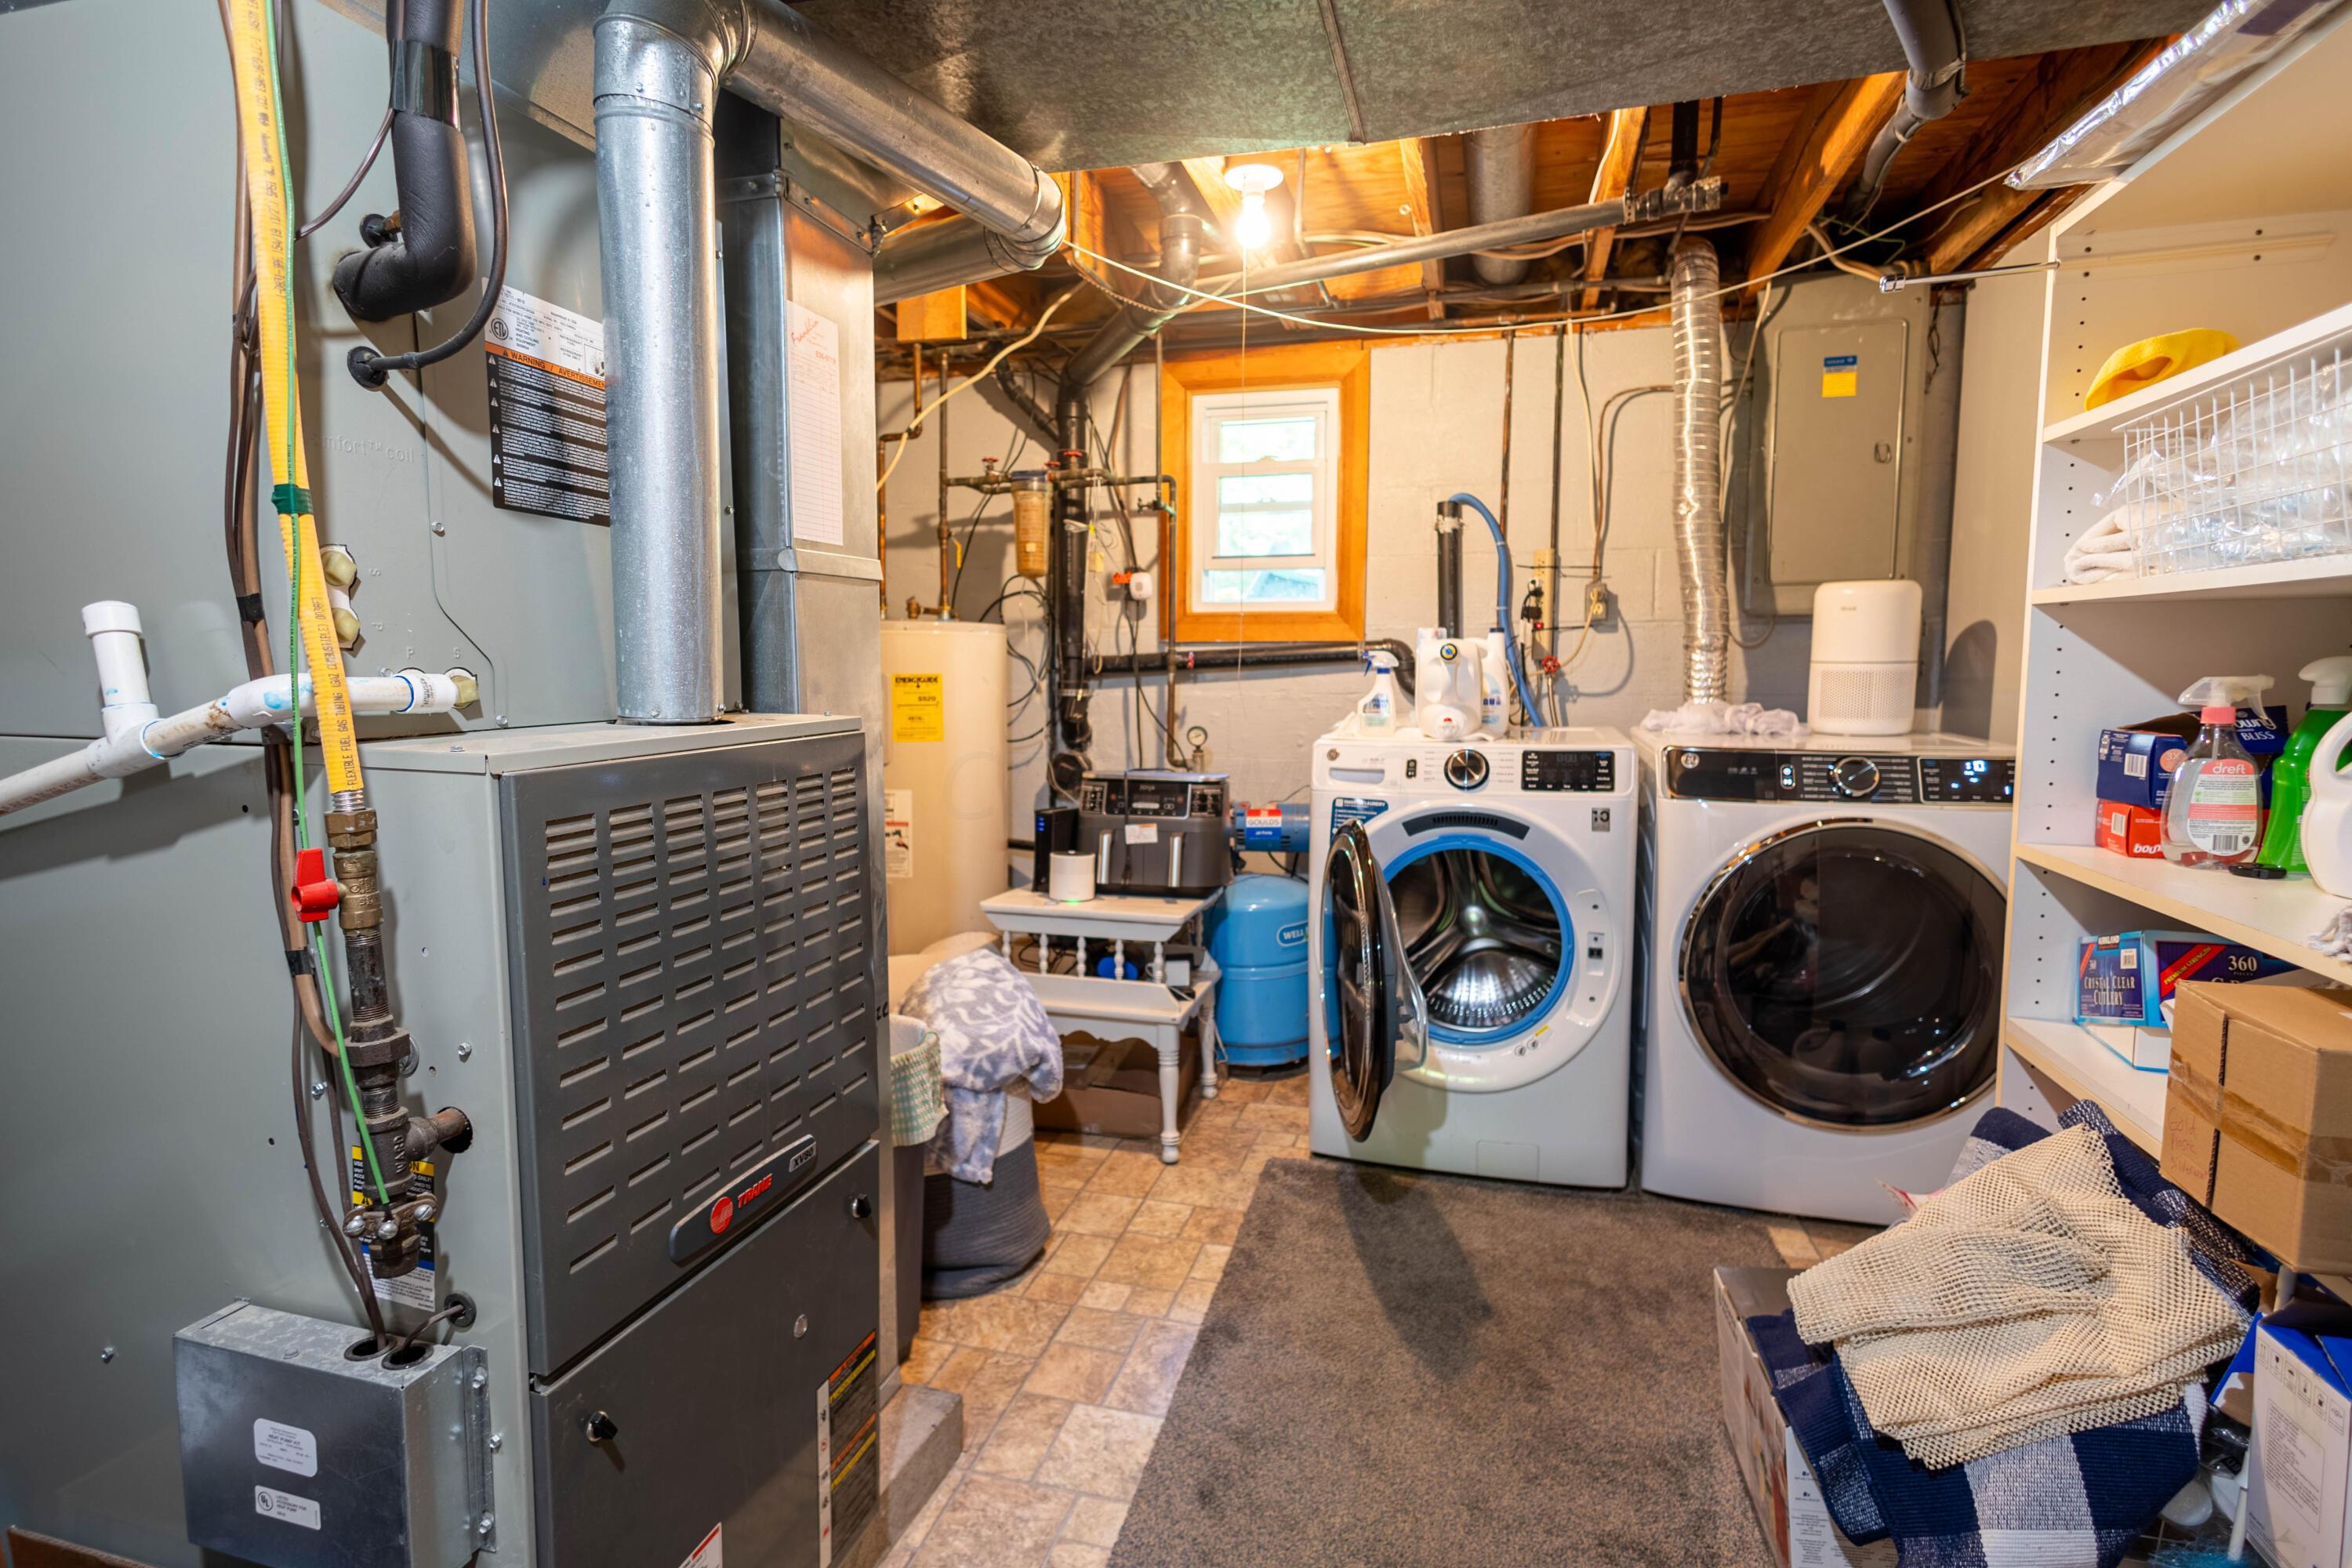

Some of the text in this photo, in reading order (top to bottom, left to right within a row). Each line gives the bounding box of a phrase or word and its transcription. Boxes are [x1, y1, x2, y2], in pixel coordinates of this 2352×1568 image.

[510, 350, 546, 369] WARNING
[558, 368, 605, 389] AVERTISSEMEN
[332, 692, 346, 717] TUBING
[336, 720, 349, 732] GAS
[2234, 718, 2277, 730] owny
[339, 735, 352, 751] FUEL
[2241, 731, 2275, 741] BLISS
[343, 755, 358, 786] FLEXIBLE
[2212, 762, 2246, 774] dreft
[1247, 818, 1280, 826] GOULDS
[1283, 928, 1304, 941] WELL
[2163, 946, 2212, 985] PREMIUM STRENGTH
[2227, 955, 2258, 971] 360
[2084, 975, 2136, 989] CRYSTAL CLEAR
[2093, 989, 2123, 1006] CUTLERY
[393, 1135, 407, 1173] WARD
[793, 1147, 814, 1169] XV80
[738, 1173, 772, 1209] TRANE
